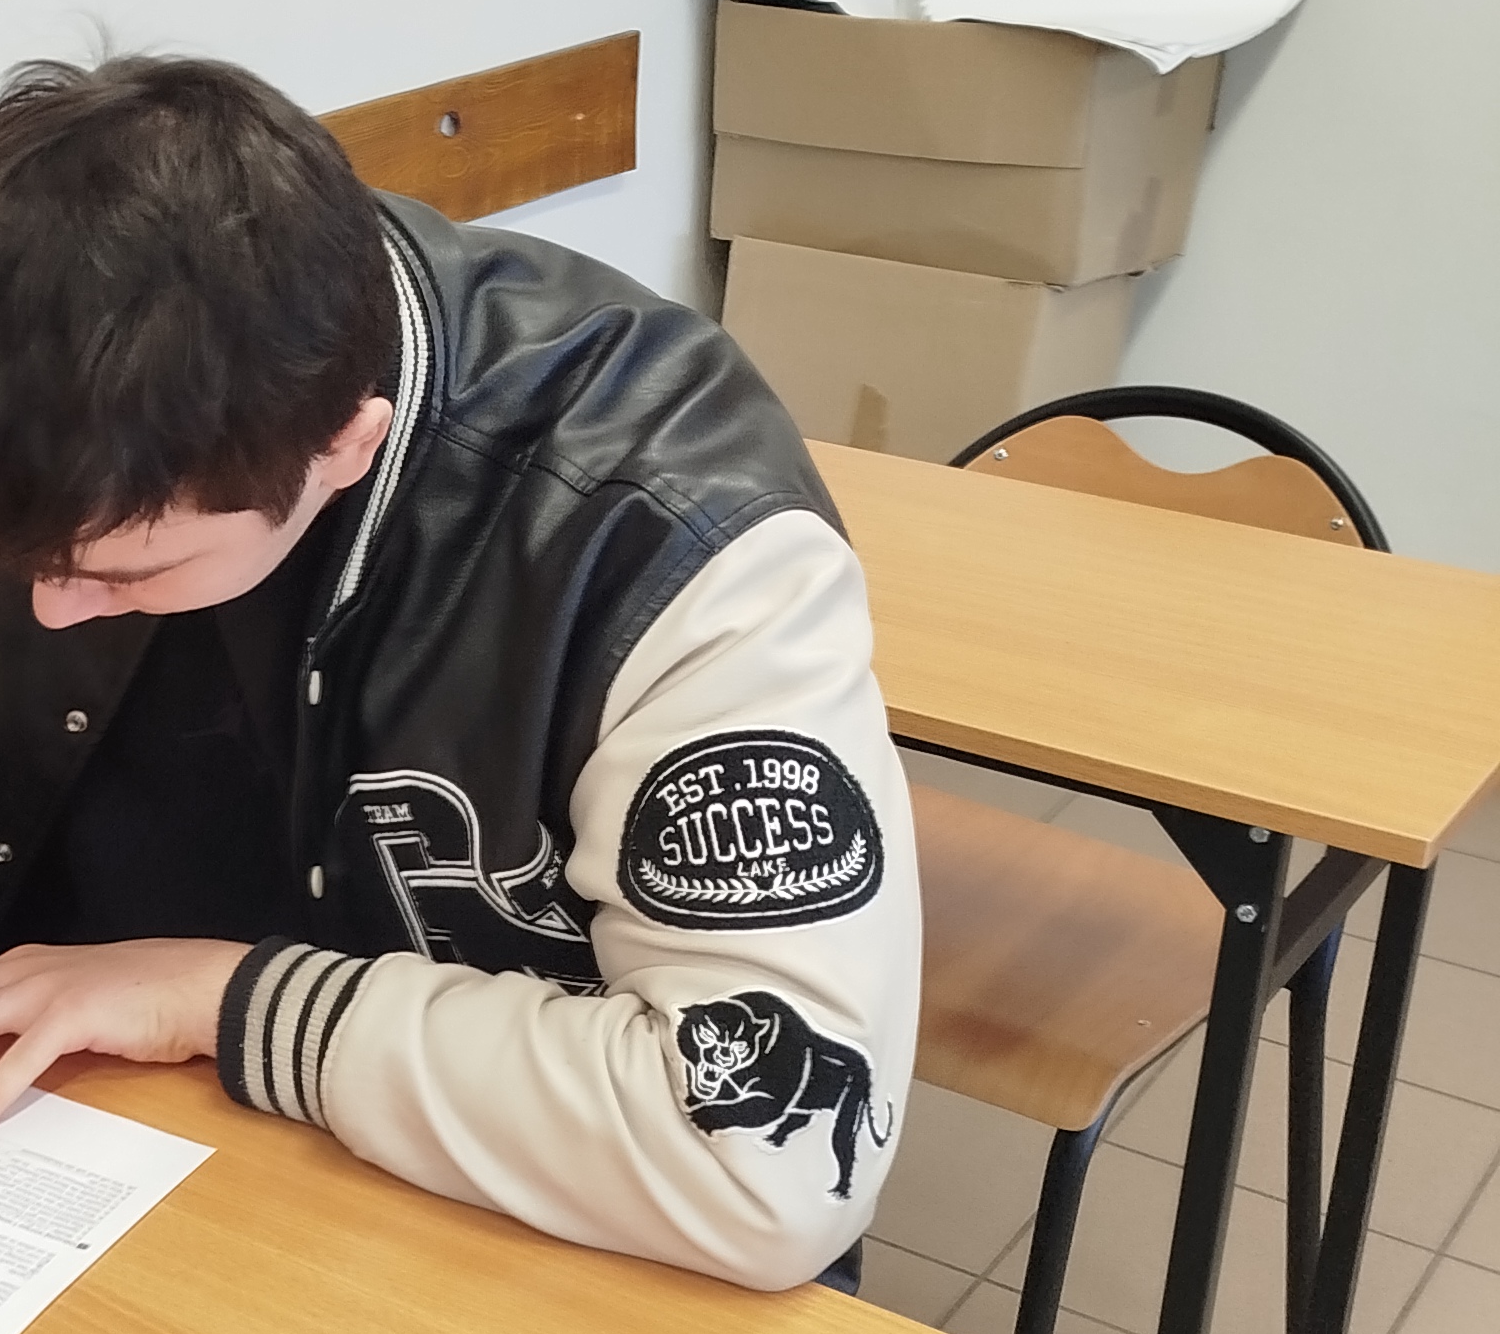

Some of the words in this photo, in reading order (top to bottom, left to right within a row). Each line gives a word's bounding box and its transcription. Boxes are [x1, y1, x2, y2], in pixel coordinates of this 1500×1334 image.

[363, 802, 414, 824] TEAM
[658, 797, 835, 867] SUCCESS
[736, 857, 790, 878] LAKE
